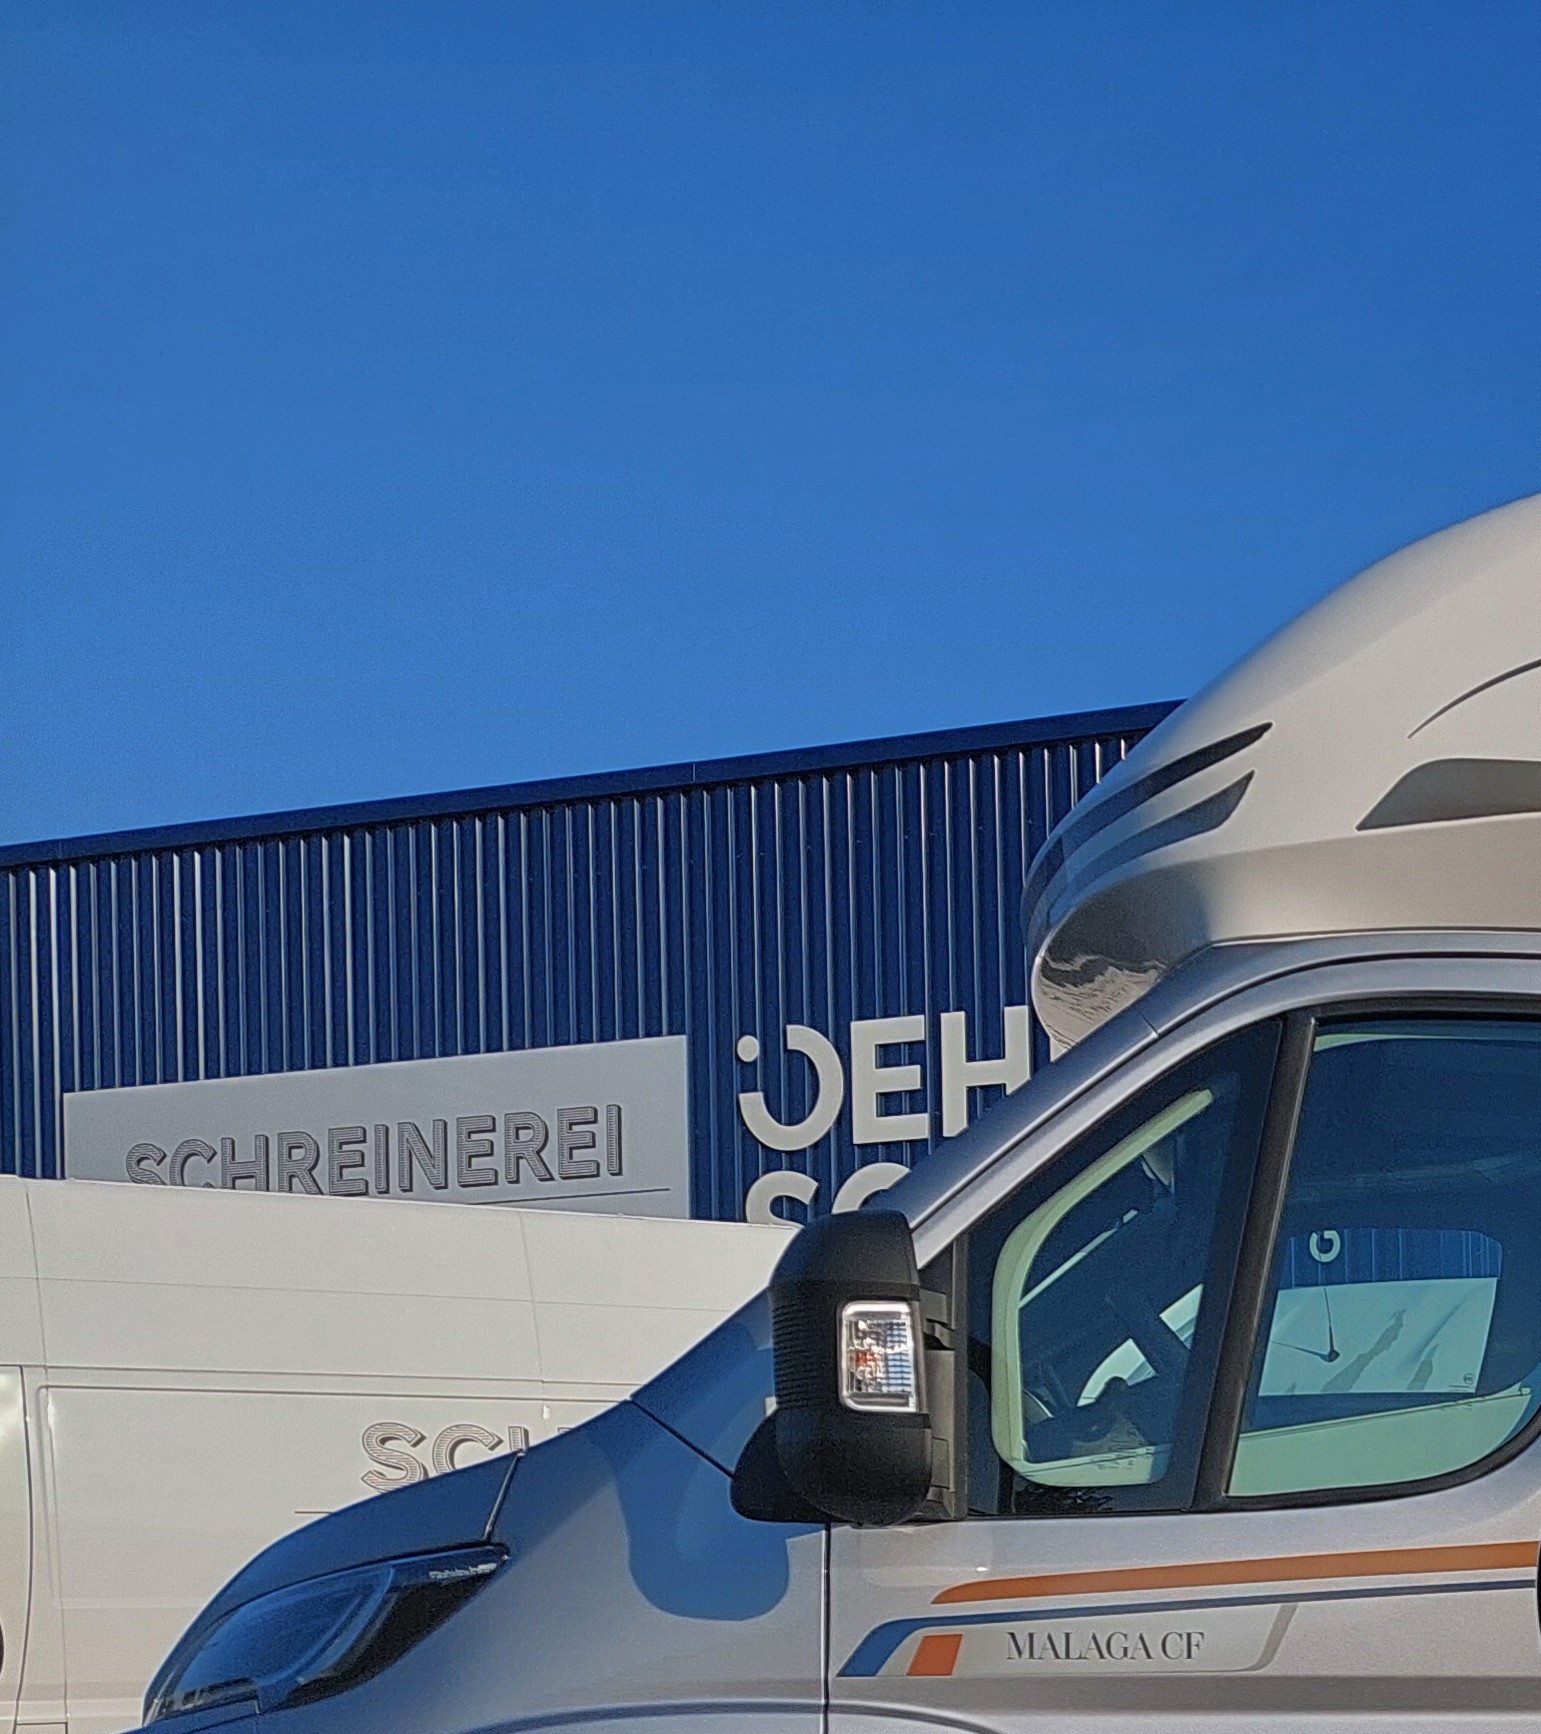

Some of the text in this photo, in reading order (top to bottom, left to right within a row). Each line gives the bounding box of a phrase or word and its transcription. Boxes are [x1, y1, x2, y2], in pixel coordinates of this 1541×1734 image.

[125, 1103, 624, 1197] SCHREINEREI
[1006, 1630, 1205, 1660] MALAGA CF
